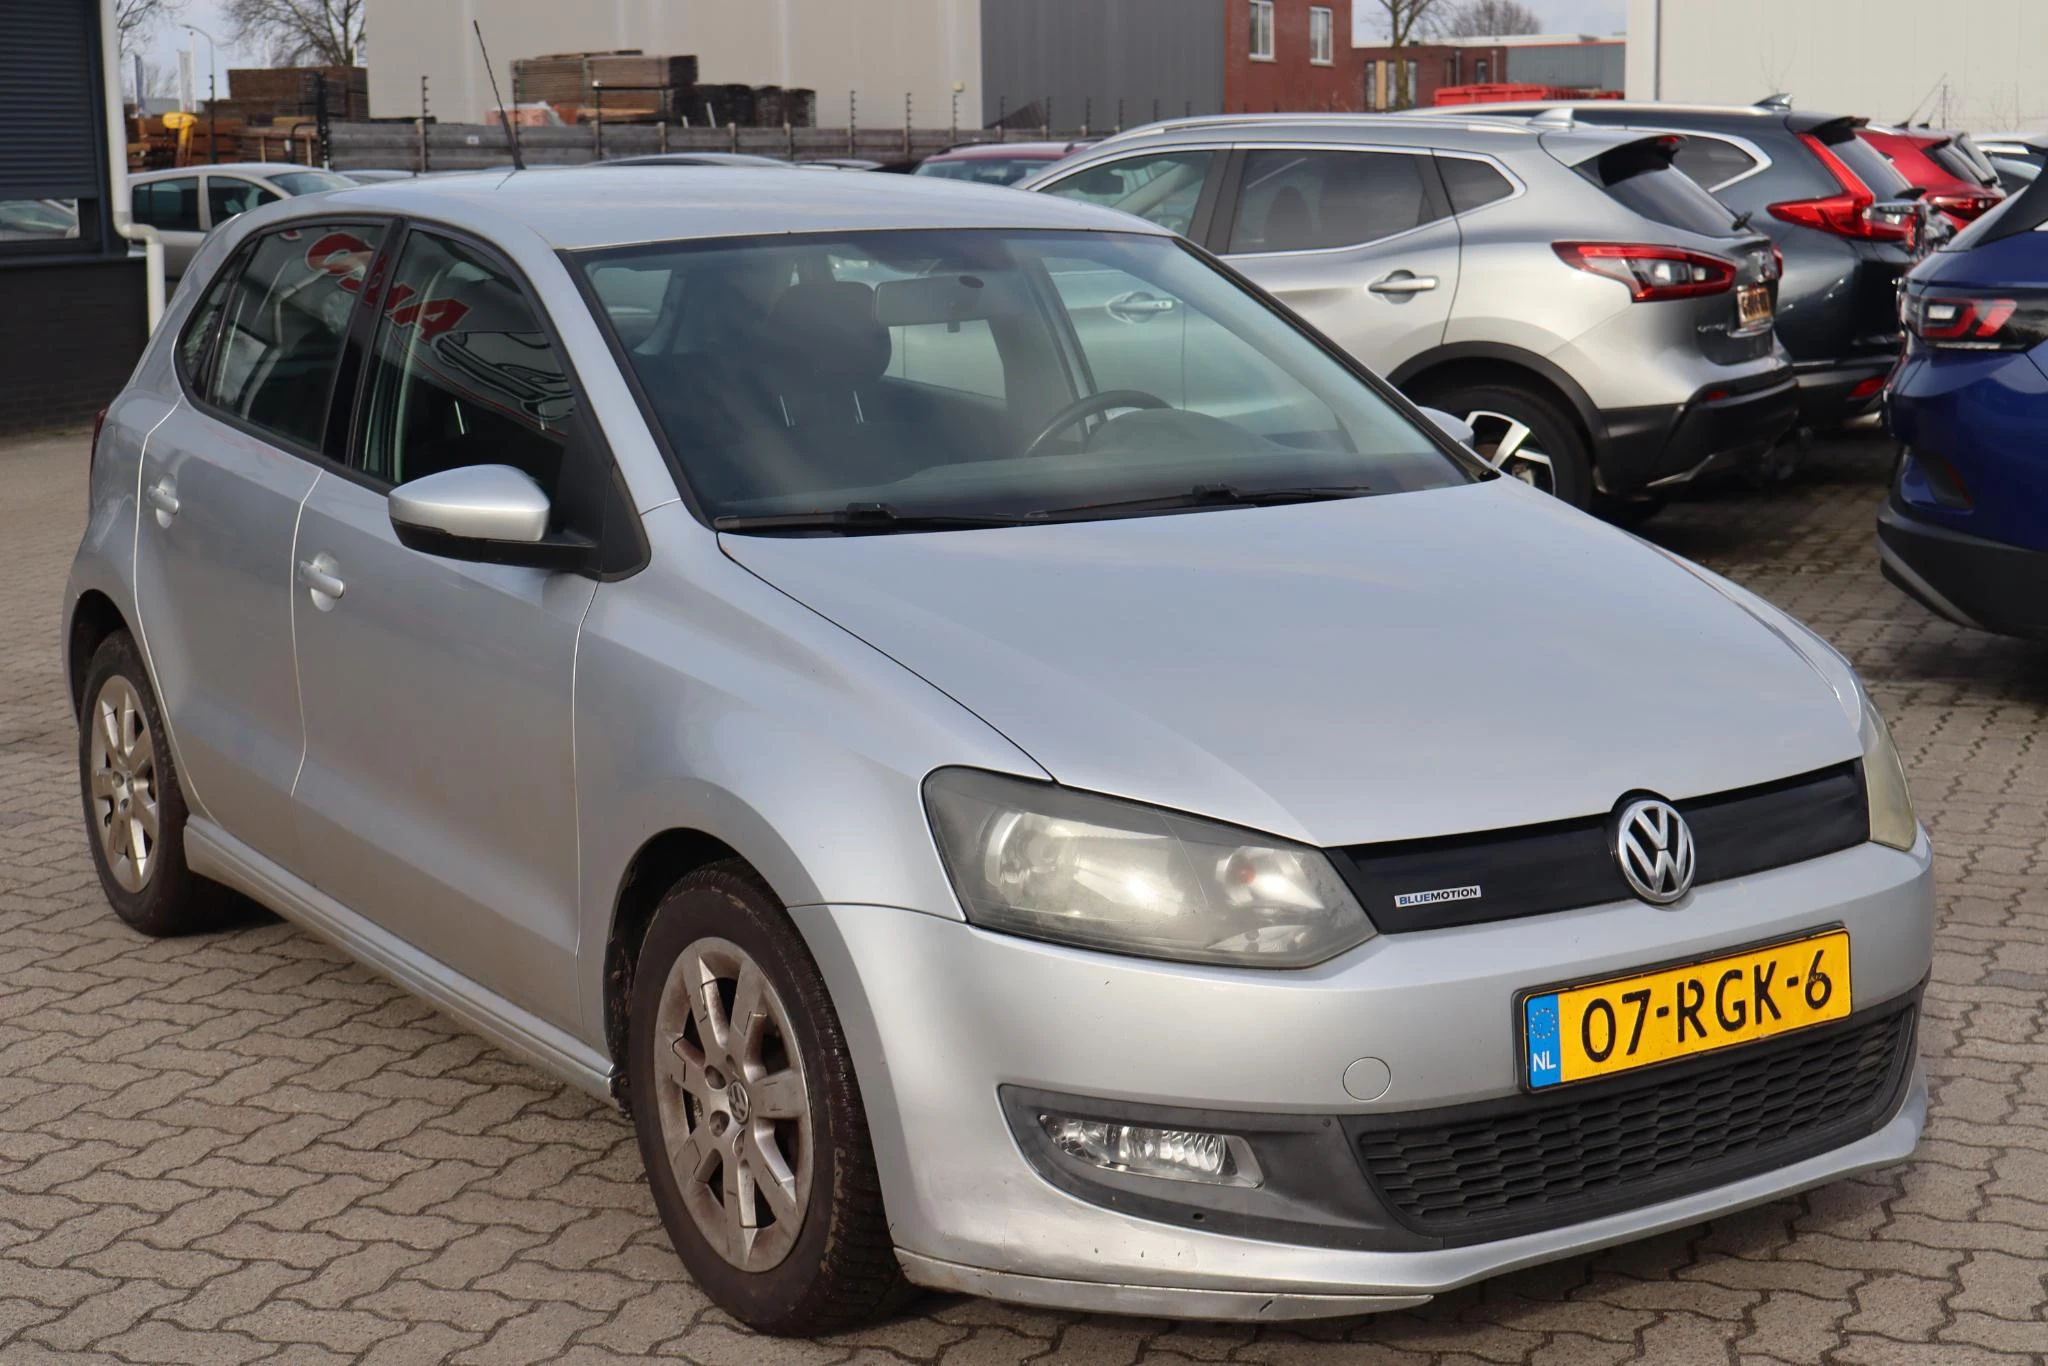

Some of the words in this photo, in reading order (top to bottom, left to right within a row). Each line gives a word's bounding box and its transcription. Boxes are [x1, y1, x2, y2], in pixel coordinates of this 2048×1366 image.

[1399, 887, 1478, 905] BLUEMOTION
[1580, 949, 1832, 1063] 07-RGK-6
[1532, 1051, 1557, 1073] NL
